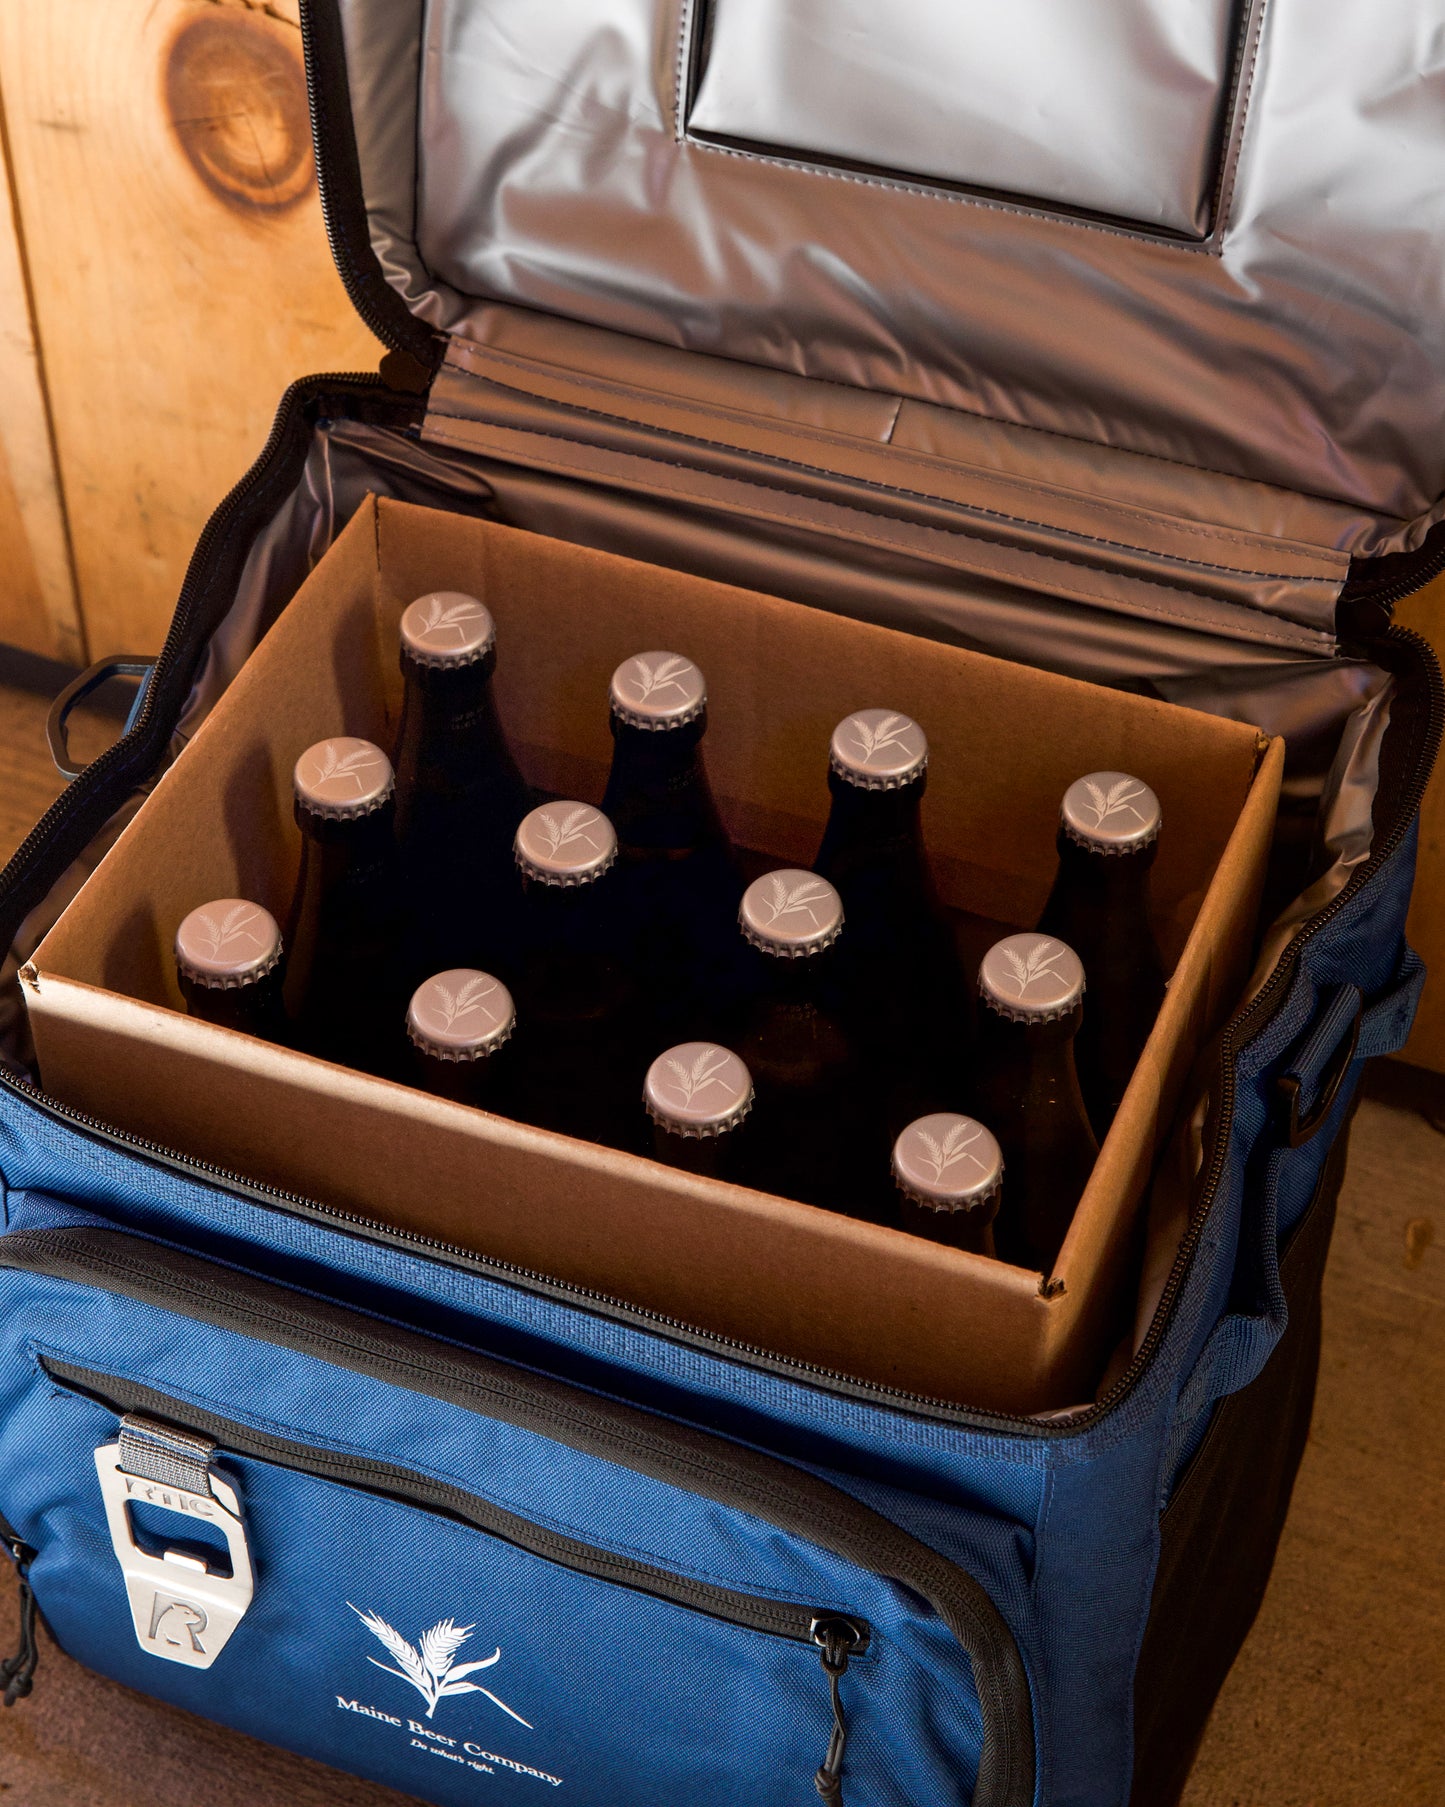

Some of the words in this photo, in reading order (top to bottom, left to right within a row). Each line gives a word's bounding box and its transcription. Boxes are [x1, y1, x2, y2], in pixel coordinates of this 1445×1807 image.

[125, 1478, 214, 1516] RTIC
[336, 1696, 402, 1727] Maine
[407, 1719, 457, 1748] Beer
[463, 1742, 563, 1786] Company
[410, 1739, 428, 1751] Do
[430, 1747, 465, 1764] what's
